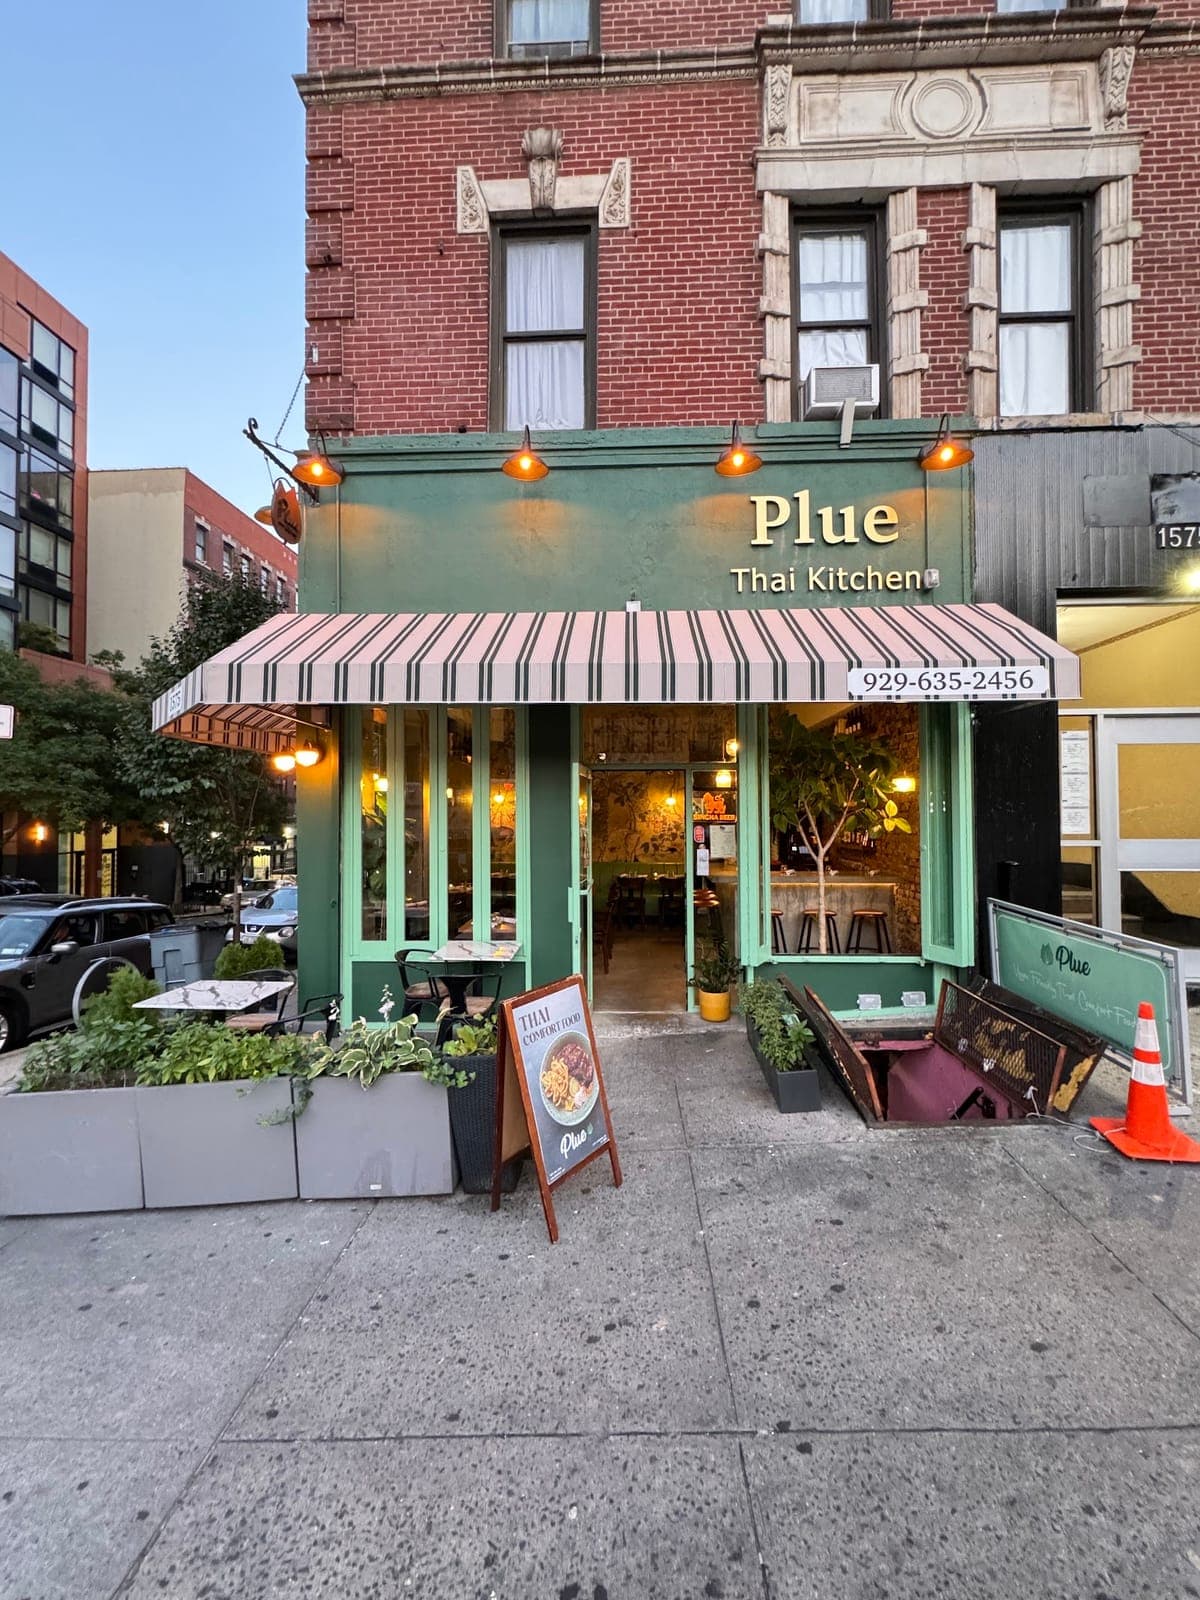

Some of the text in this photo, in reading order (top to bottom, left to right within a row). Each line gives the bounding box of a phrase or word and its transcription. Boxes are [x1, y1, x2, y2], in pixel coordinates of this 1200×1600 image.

[750, 489, 900, 545] Plue
[1158, 526, 1200, 547] 157
[730, 565, 921, 593] Thai Kitchen
[863, 669, 1034, 692] 929-635-2456
[1055, 945, 1091, 976] Plue
[518, 1006, 550, 1031] THAI
[522, 1012, 581, 1046] COMFORT FOOD
[560, 1129, 588, 1159] Plue
